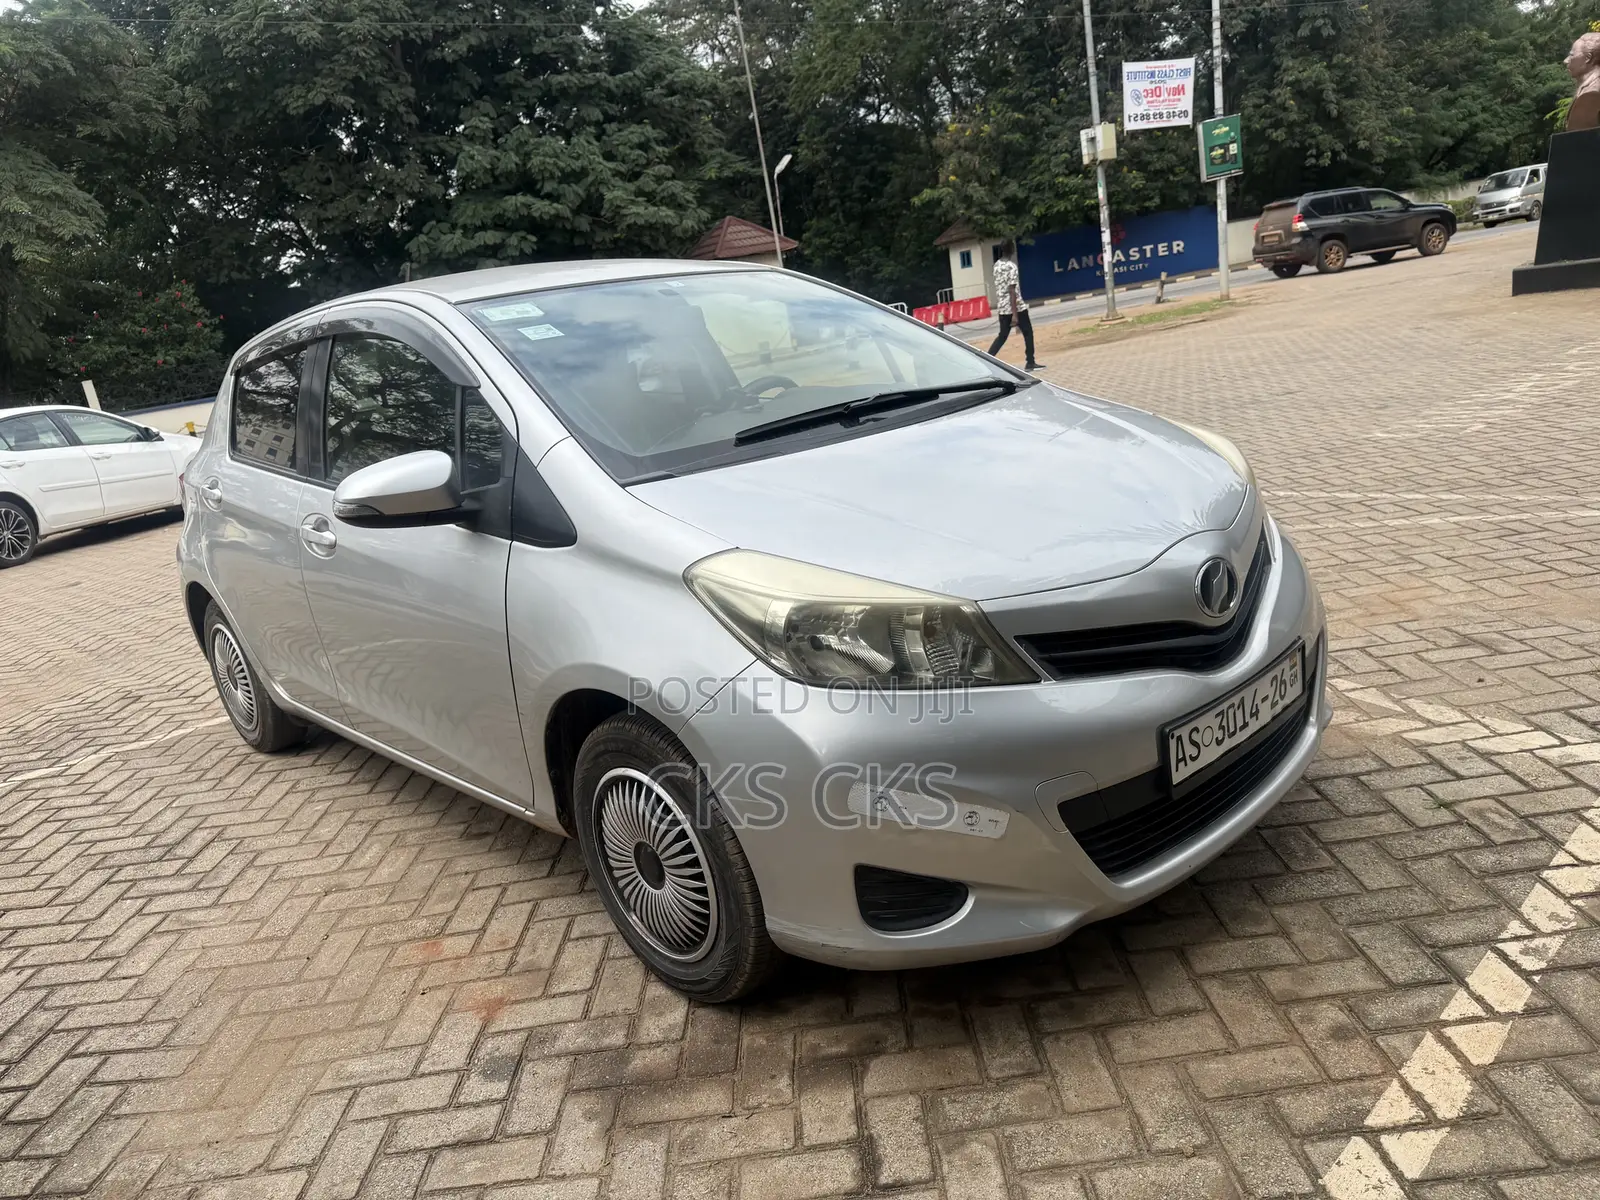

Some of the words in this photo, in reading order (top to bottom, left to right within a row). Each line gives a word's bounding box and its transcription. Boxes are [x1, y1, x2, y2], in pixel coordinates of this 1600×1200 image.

[1130, 263, 1149, 271] CITY
[1289, 669, 1299, 688] GH
[1175, 726, 1202, 772] AS
